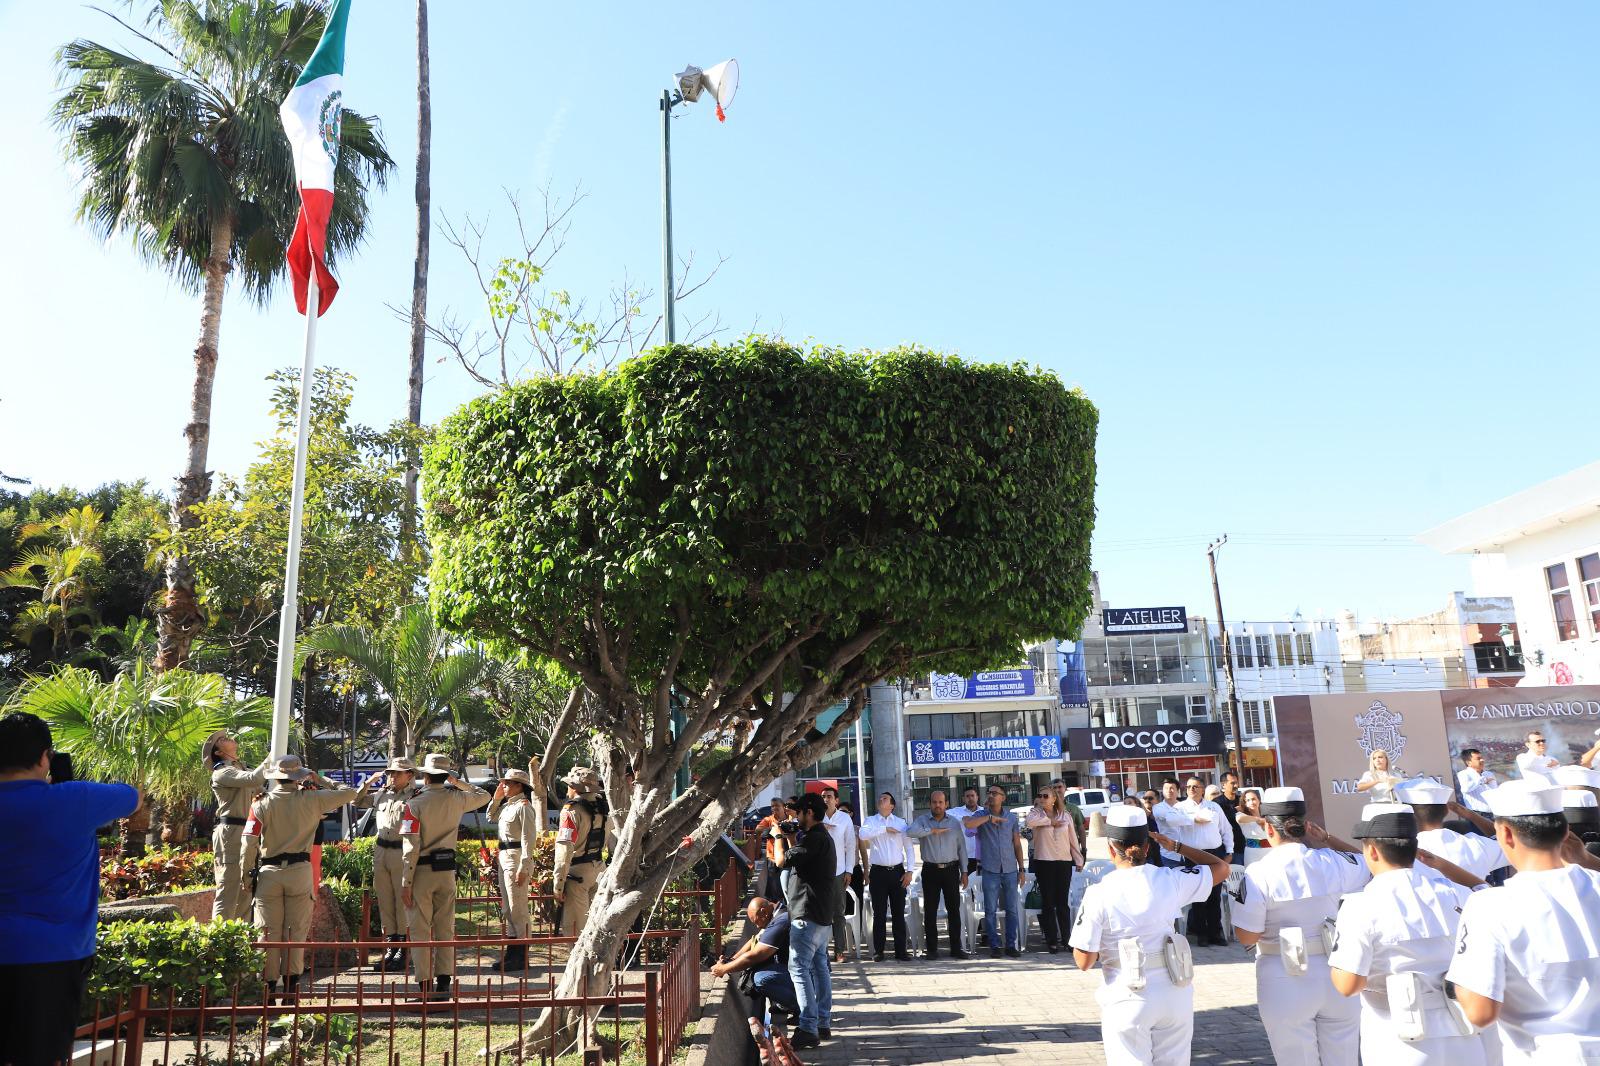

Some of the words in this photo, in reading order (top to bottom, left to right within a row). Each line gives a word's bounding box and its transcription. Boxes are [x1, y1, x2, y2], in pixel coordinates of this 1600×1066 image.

[1456, 705, 1478, 719] 162
[1482, 702, 1584, 718] ANIVERSARIO
[943, 740, 986, 750] DOCTORES
[986, 738, 1029, 749] PEDIATRAS
[938, 751, 971, 763] CENTRO
[971, 751, 983, 762] DE
[984, 748, 1036, 761] VACUNACIÓN
